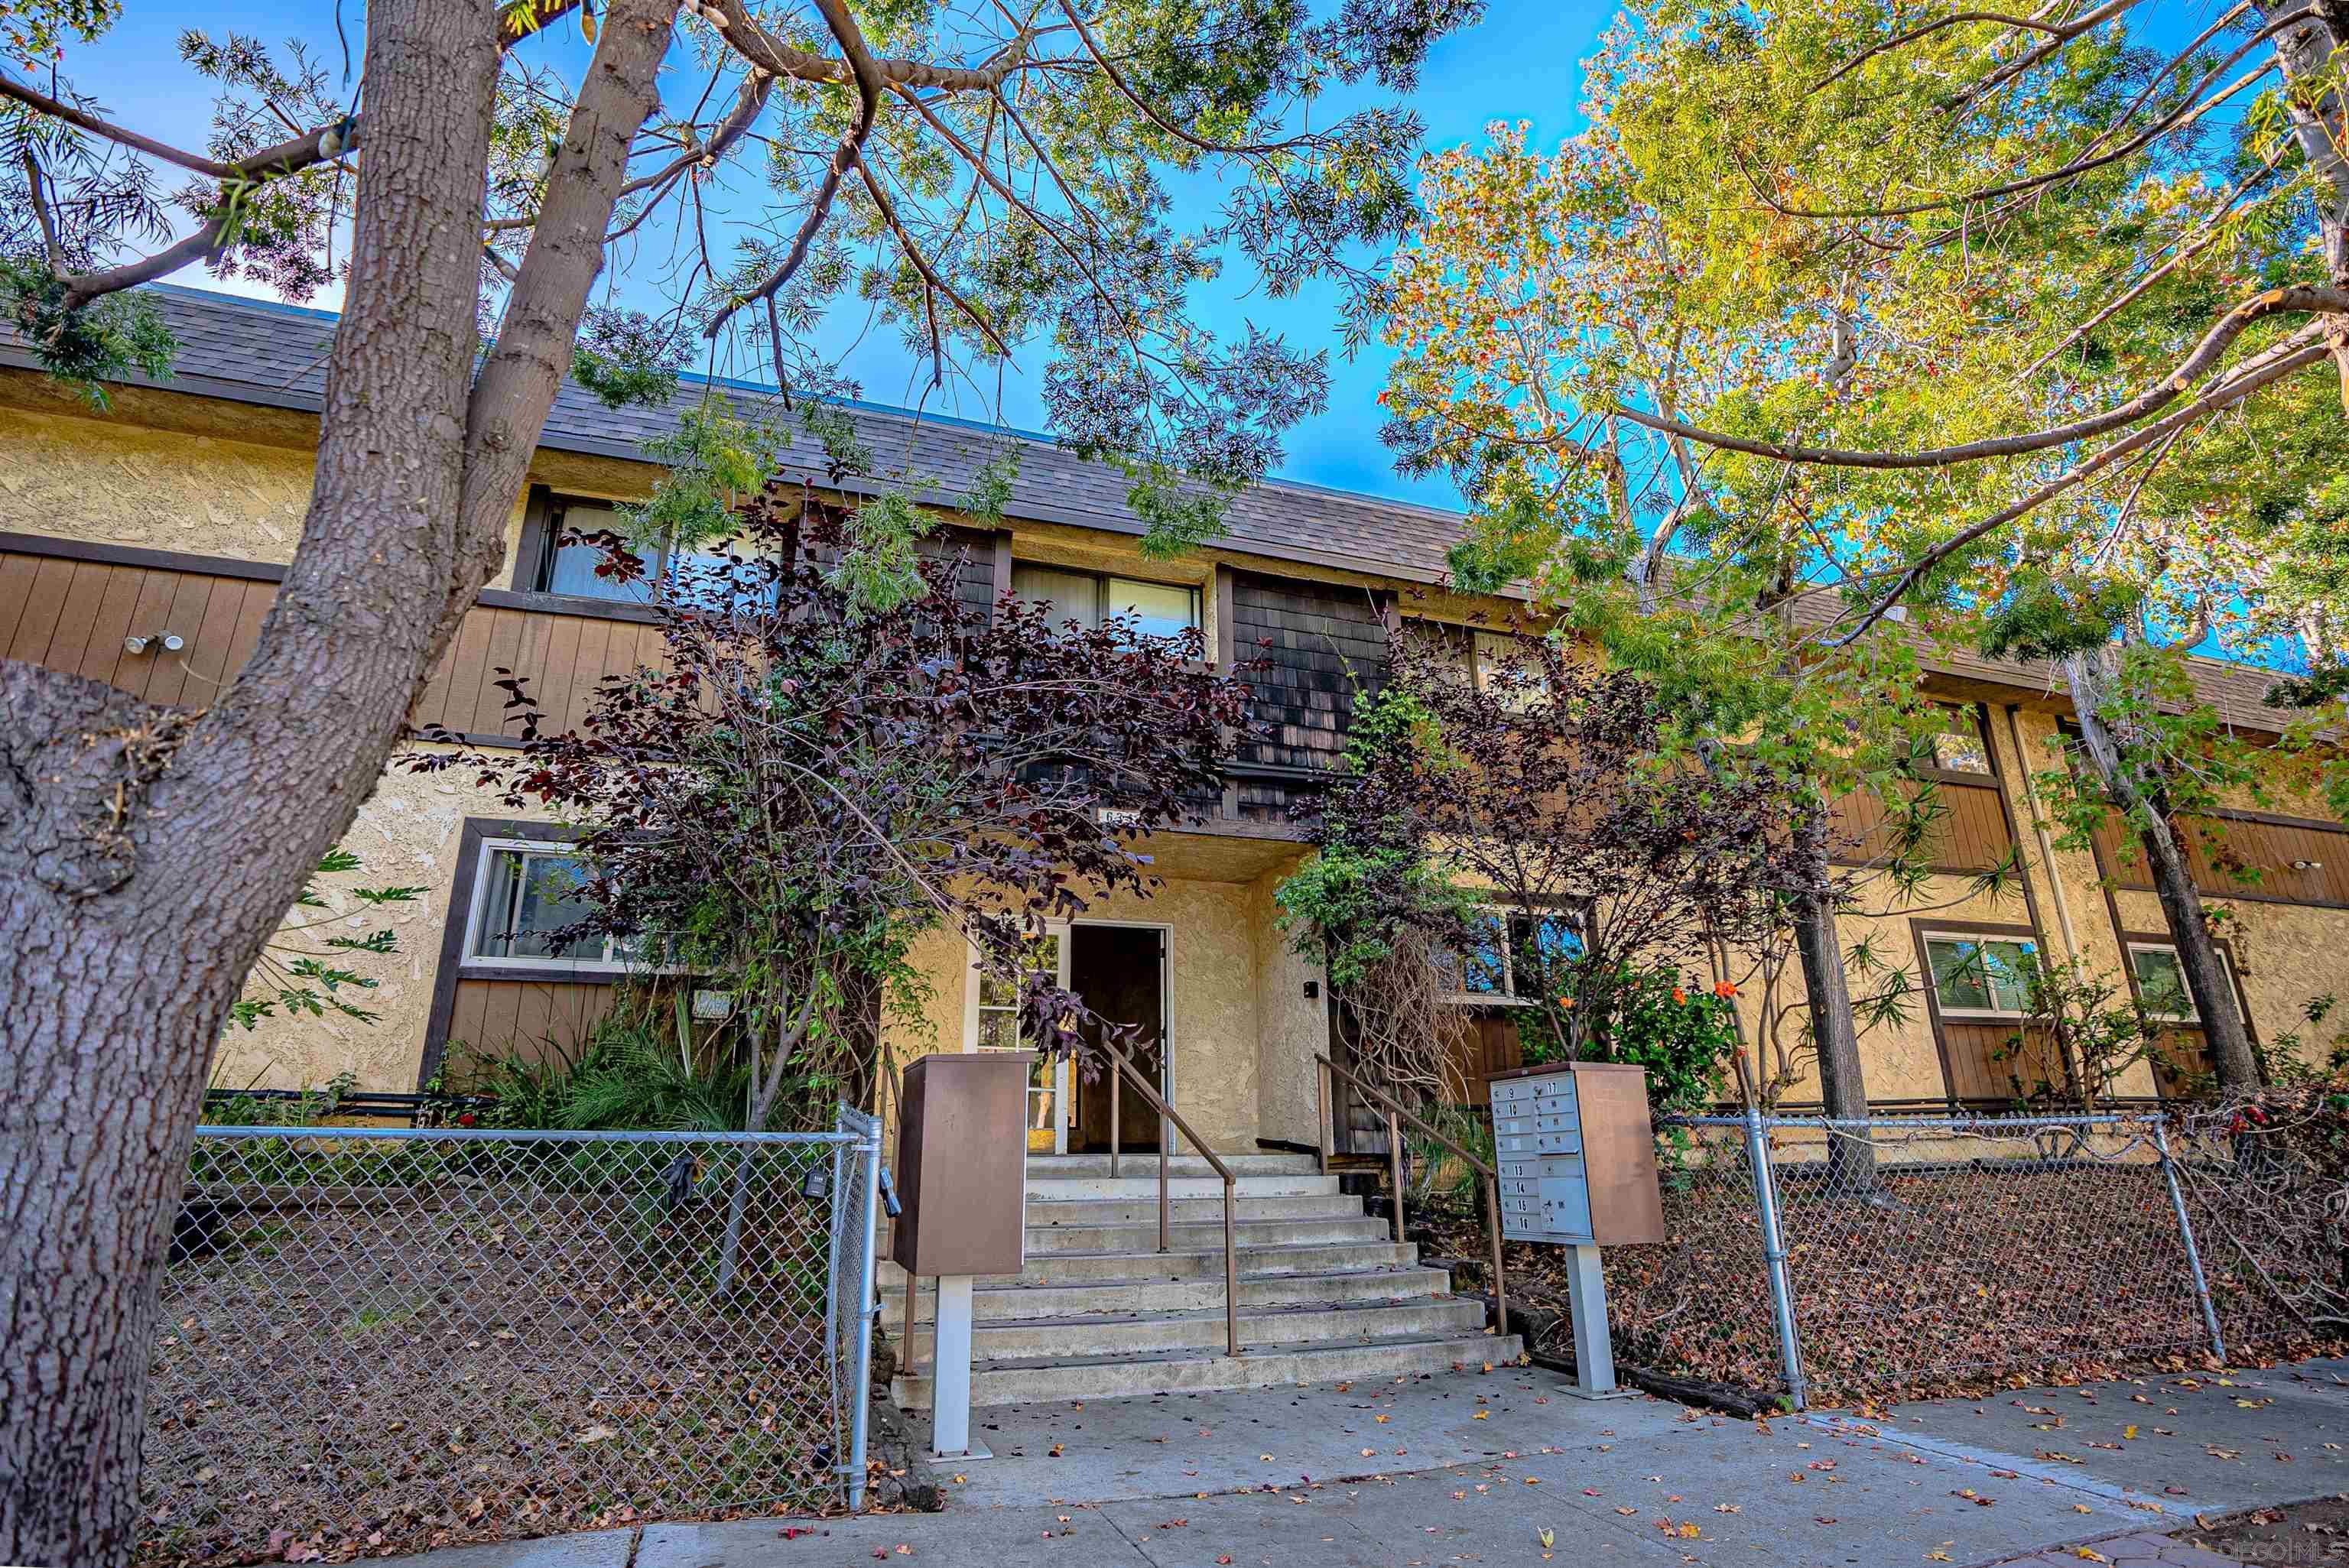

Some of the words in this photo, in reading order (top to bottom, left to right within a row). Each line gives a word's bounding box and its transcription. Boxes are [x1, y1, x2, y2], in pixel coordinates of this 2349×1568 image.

[1509, 1088, 1513, 1099] 9
[1509, 1104, 1517, 1115] 10
[1515, 1166, 1522, 1176] 13
[1516, 1182, 1525, 1193] 14
[1518, 1200, 1526, 1212] 15
[1519, 1218, 1528, 1229] 16
